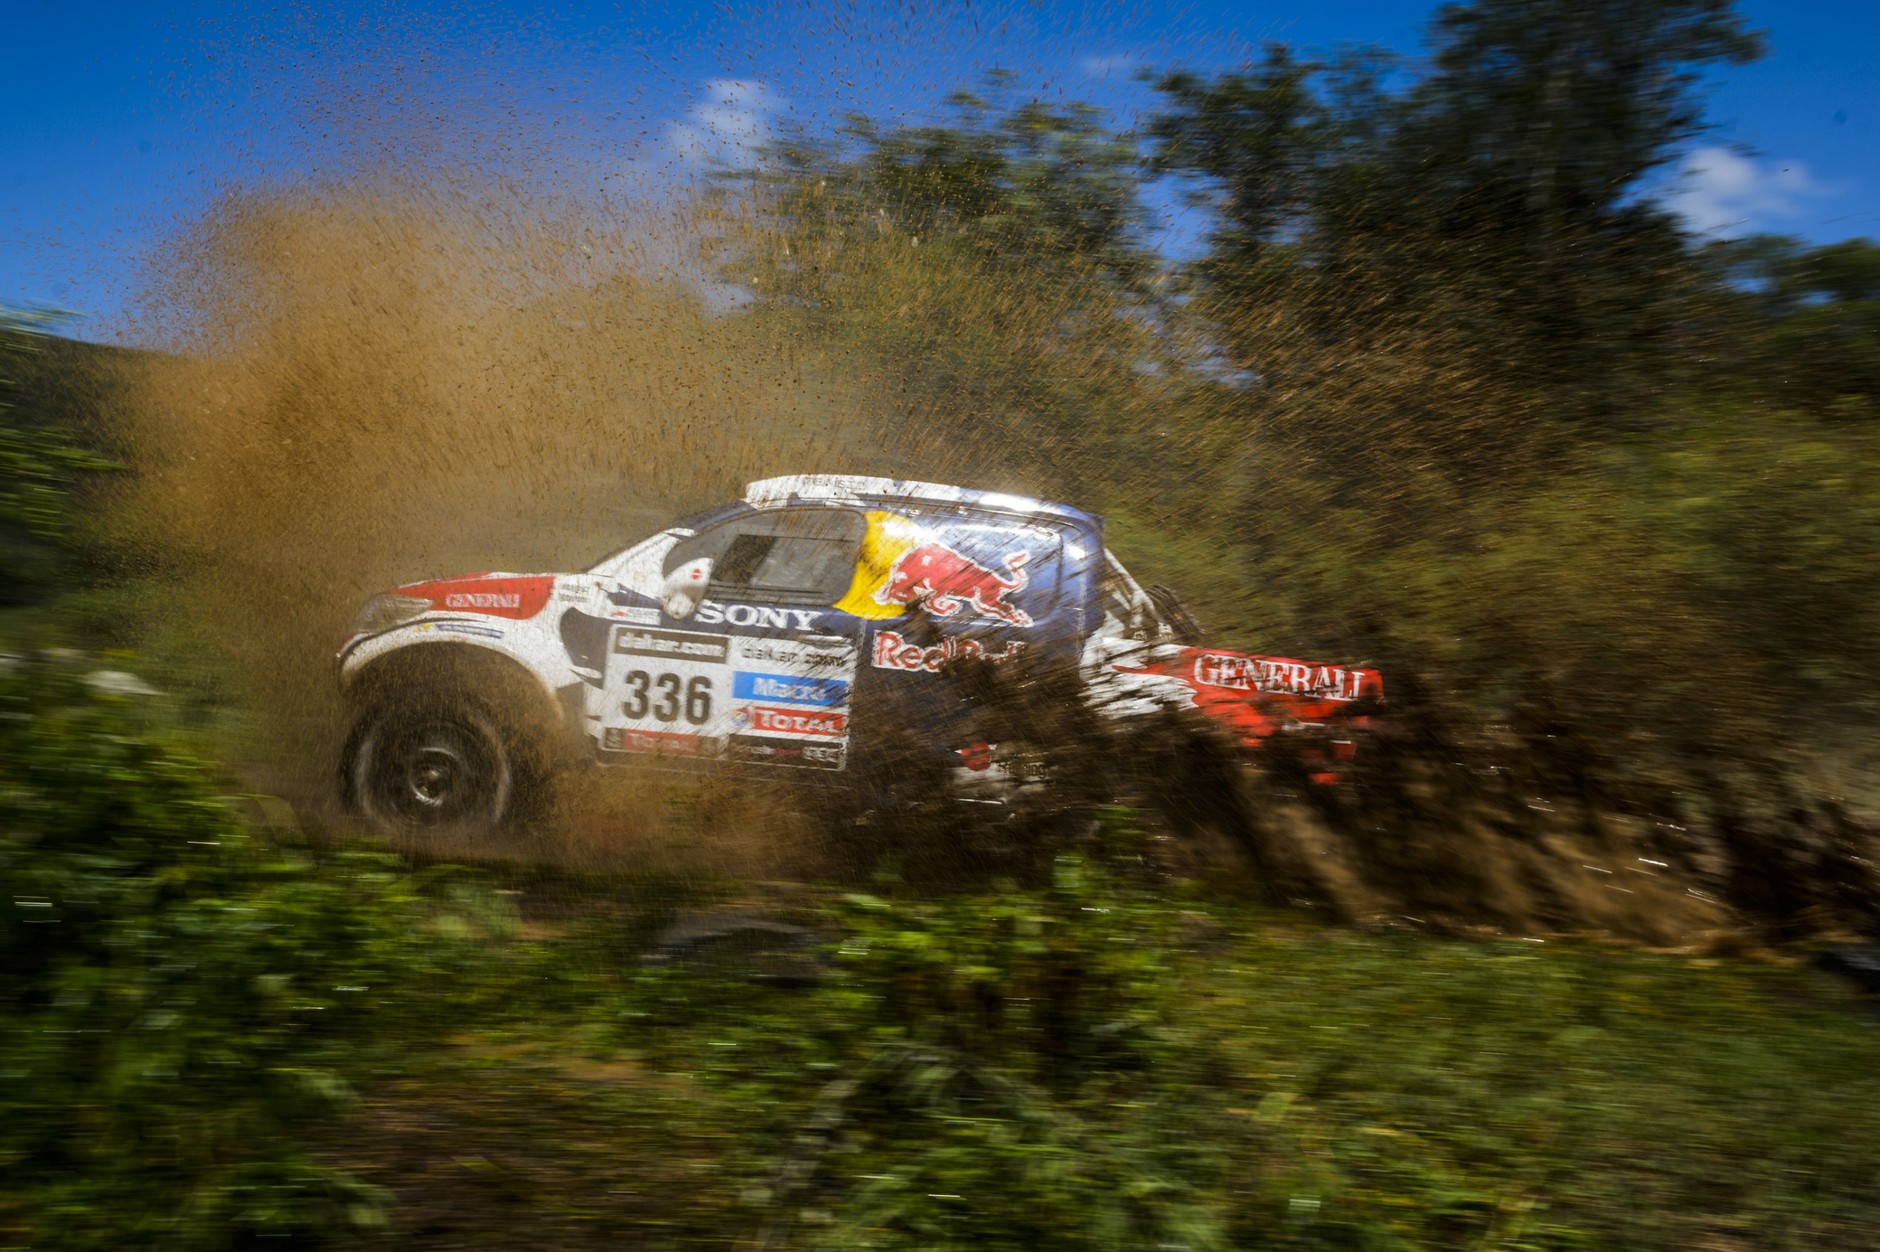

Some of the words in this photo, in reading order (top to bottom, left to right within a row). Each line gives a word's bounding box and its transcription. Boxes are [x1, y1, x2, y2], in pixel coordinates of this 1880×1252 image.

[694, 599, 823, 631] SONY
[622, 669, 712, 726] 336
[1193, 653, 1366, 702] GENERALI
[756, 709, 840, 733] TOTAL
